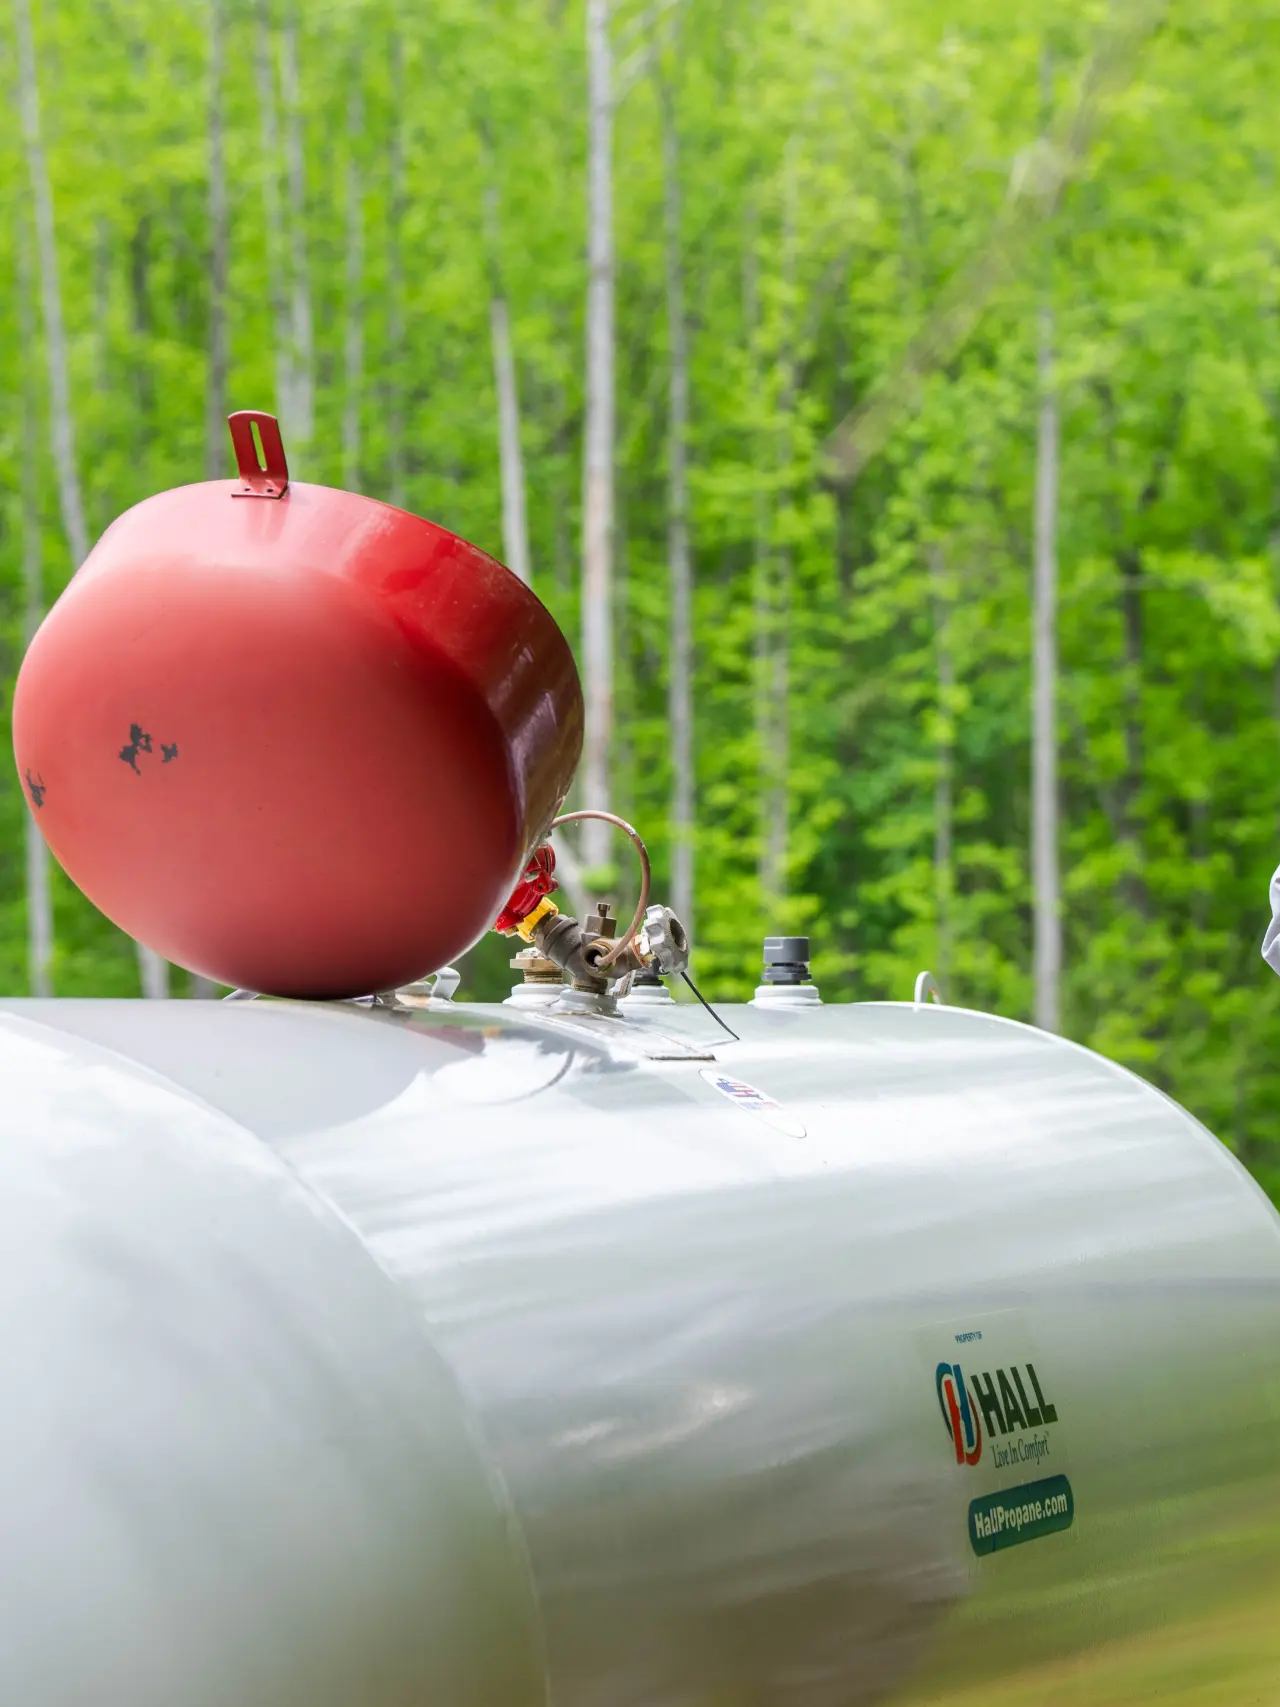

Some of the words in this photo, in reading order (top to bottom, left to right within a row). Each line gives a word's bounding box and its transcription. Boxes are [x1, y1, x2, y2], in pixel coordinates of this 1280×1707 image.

[970, 1363, 1058, 1438] HALL
[991, 1445, 1009, 1469] Live
[1008, 1440, 1019, 1465] In
[1018, 1433, 1050, 1466] Comfort
[974, 1493, 1067, 1539] HallPropane.com
